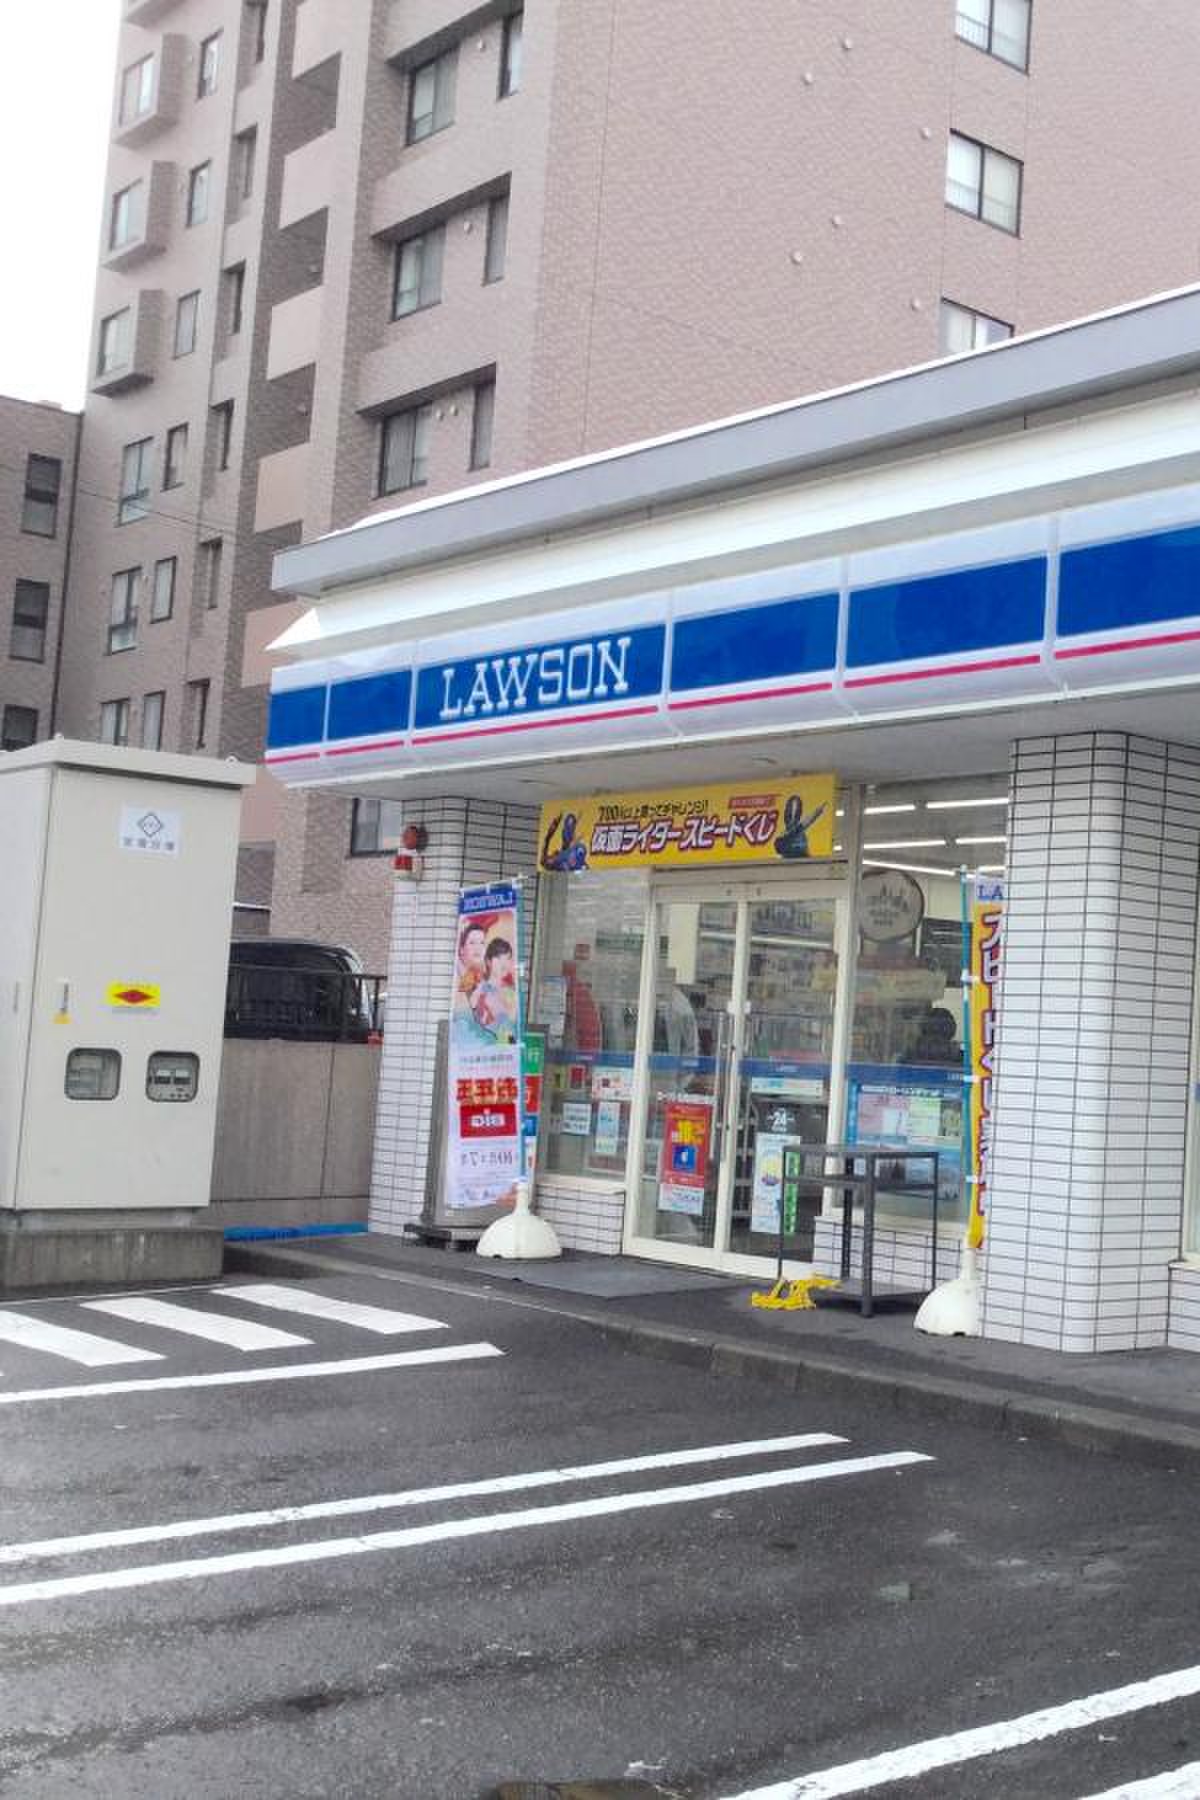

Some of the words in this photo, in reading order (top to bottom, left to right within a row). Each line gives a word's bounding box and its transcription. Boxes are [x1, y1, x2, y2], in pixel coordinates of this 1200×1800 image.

[440, 637, 631, 720] LAWSON
[591, 813, 777, 853] 仮面ライダースピードくじ
